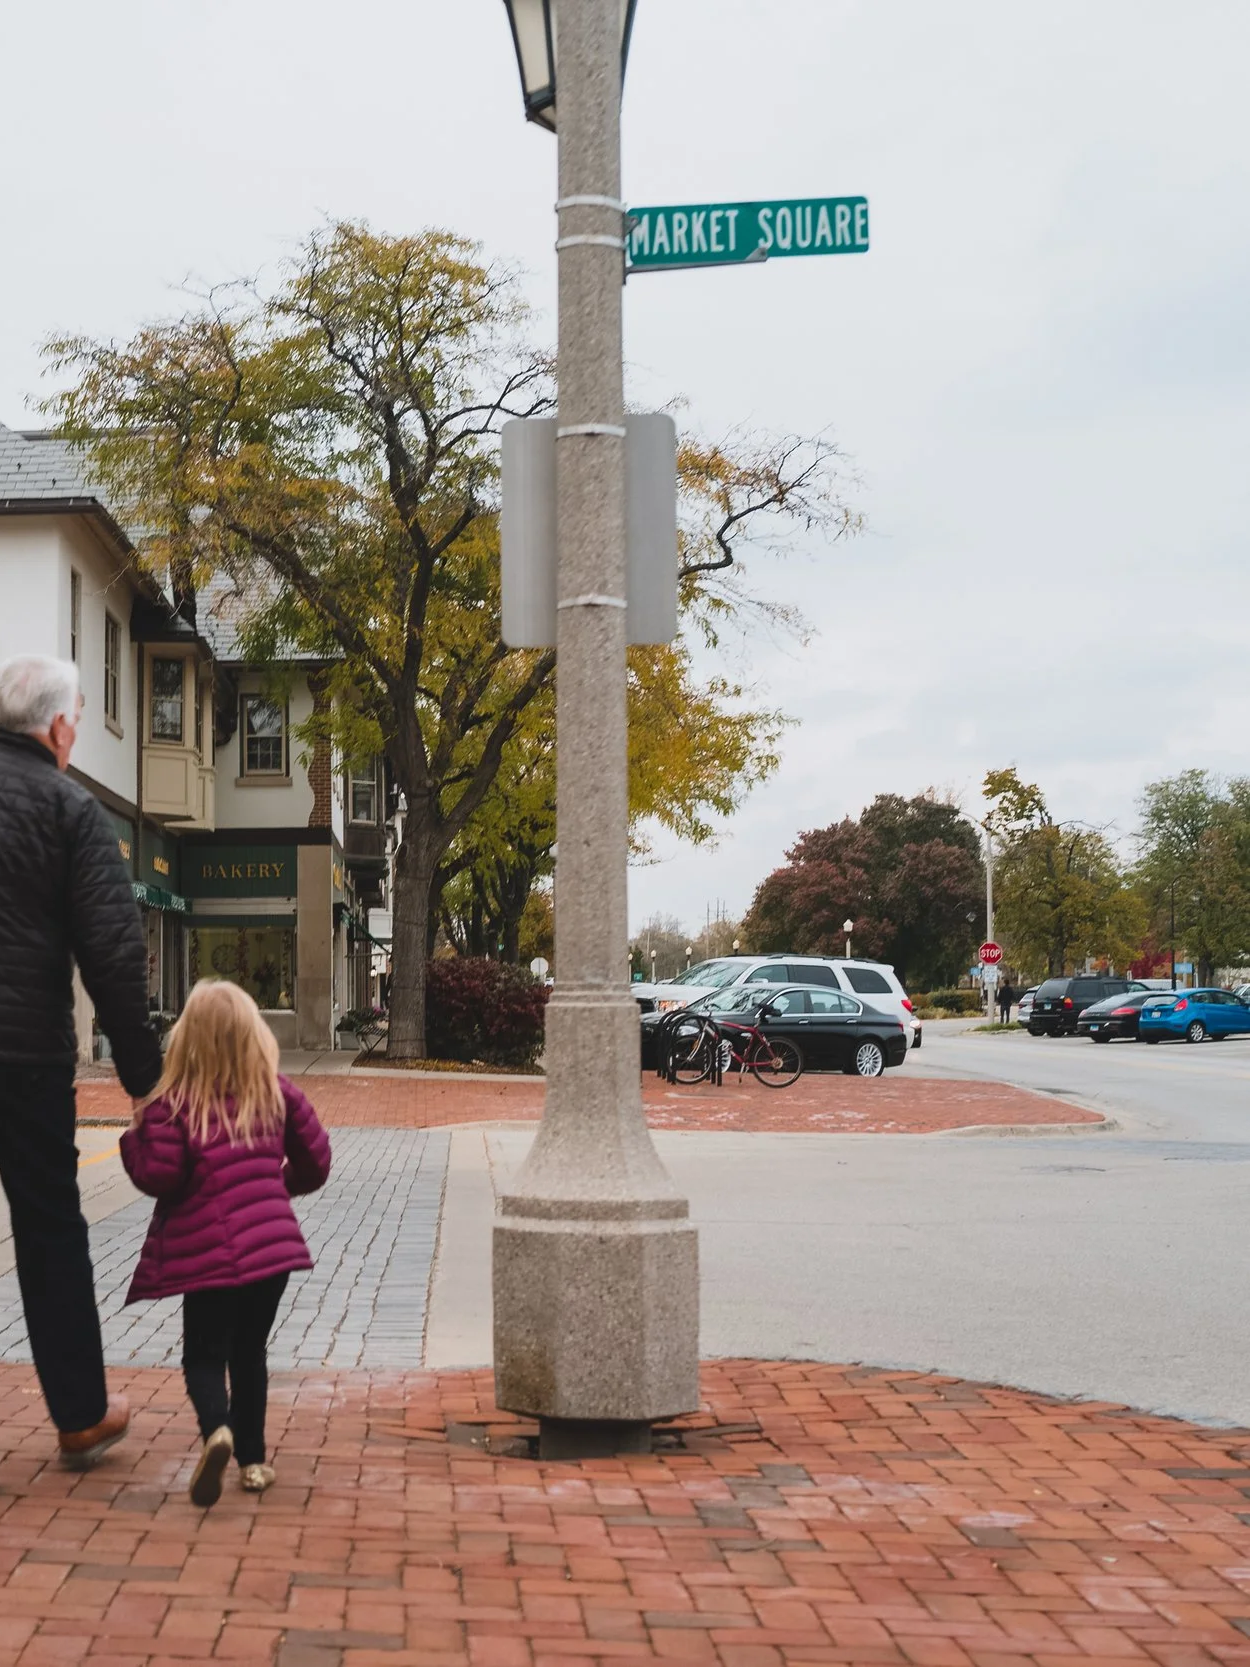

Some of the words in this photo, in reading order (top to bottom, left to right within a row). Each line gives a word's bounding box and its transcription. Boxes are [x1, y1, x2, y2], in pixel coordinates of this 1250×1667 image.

[632, 209, 739, 256] MARKET
[758, 203, 868, 250] SQUARE
[202, 862, 286, 880] BAKERY
[980, 948, 1001, 959] STOP
